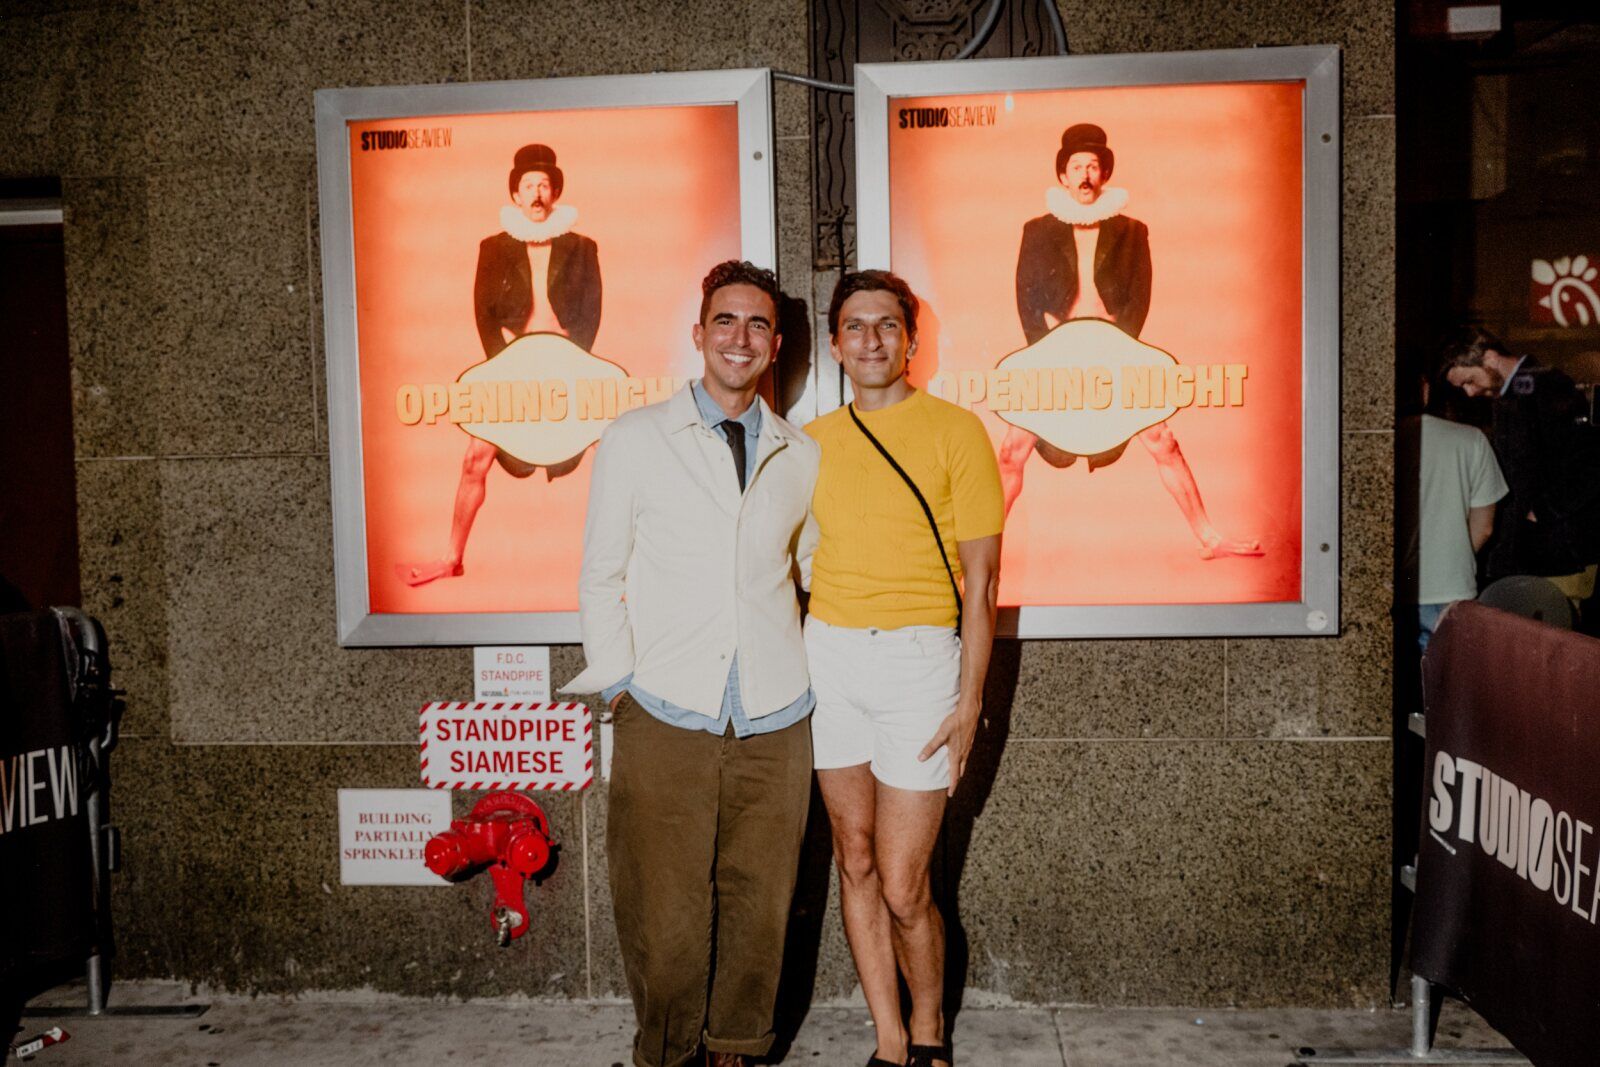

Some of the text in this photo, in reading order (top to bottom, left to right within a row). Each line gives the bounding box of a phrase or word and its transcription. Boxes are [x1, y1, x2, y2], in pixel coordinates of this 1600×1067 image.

[1121, 364, 1248, 409] NIGHT
[395, 381, 568, 425] OPENING
[496, 653, 526, 664] F.D.C.
[481, 670, 543, 681] STANDPIPE
[436, 719, 576, 741] STANDPIPE
[450, 750, 563, 773] SIAMESE
[0, 745, 78, 835] VIEW
[358, 812, 432, 825] BUILDING
